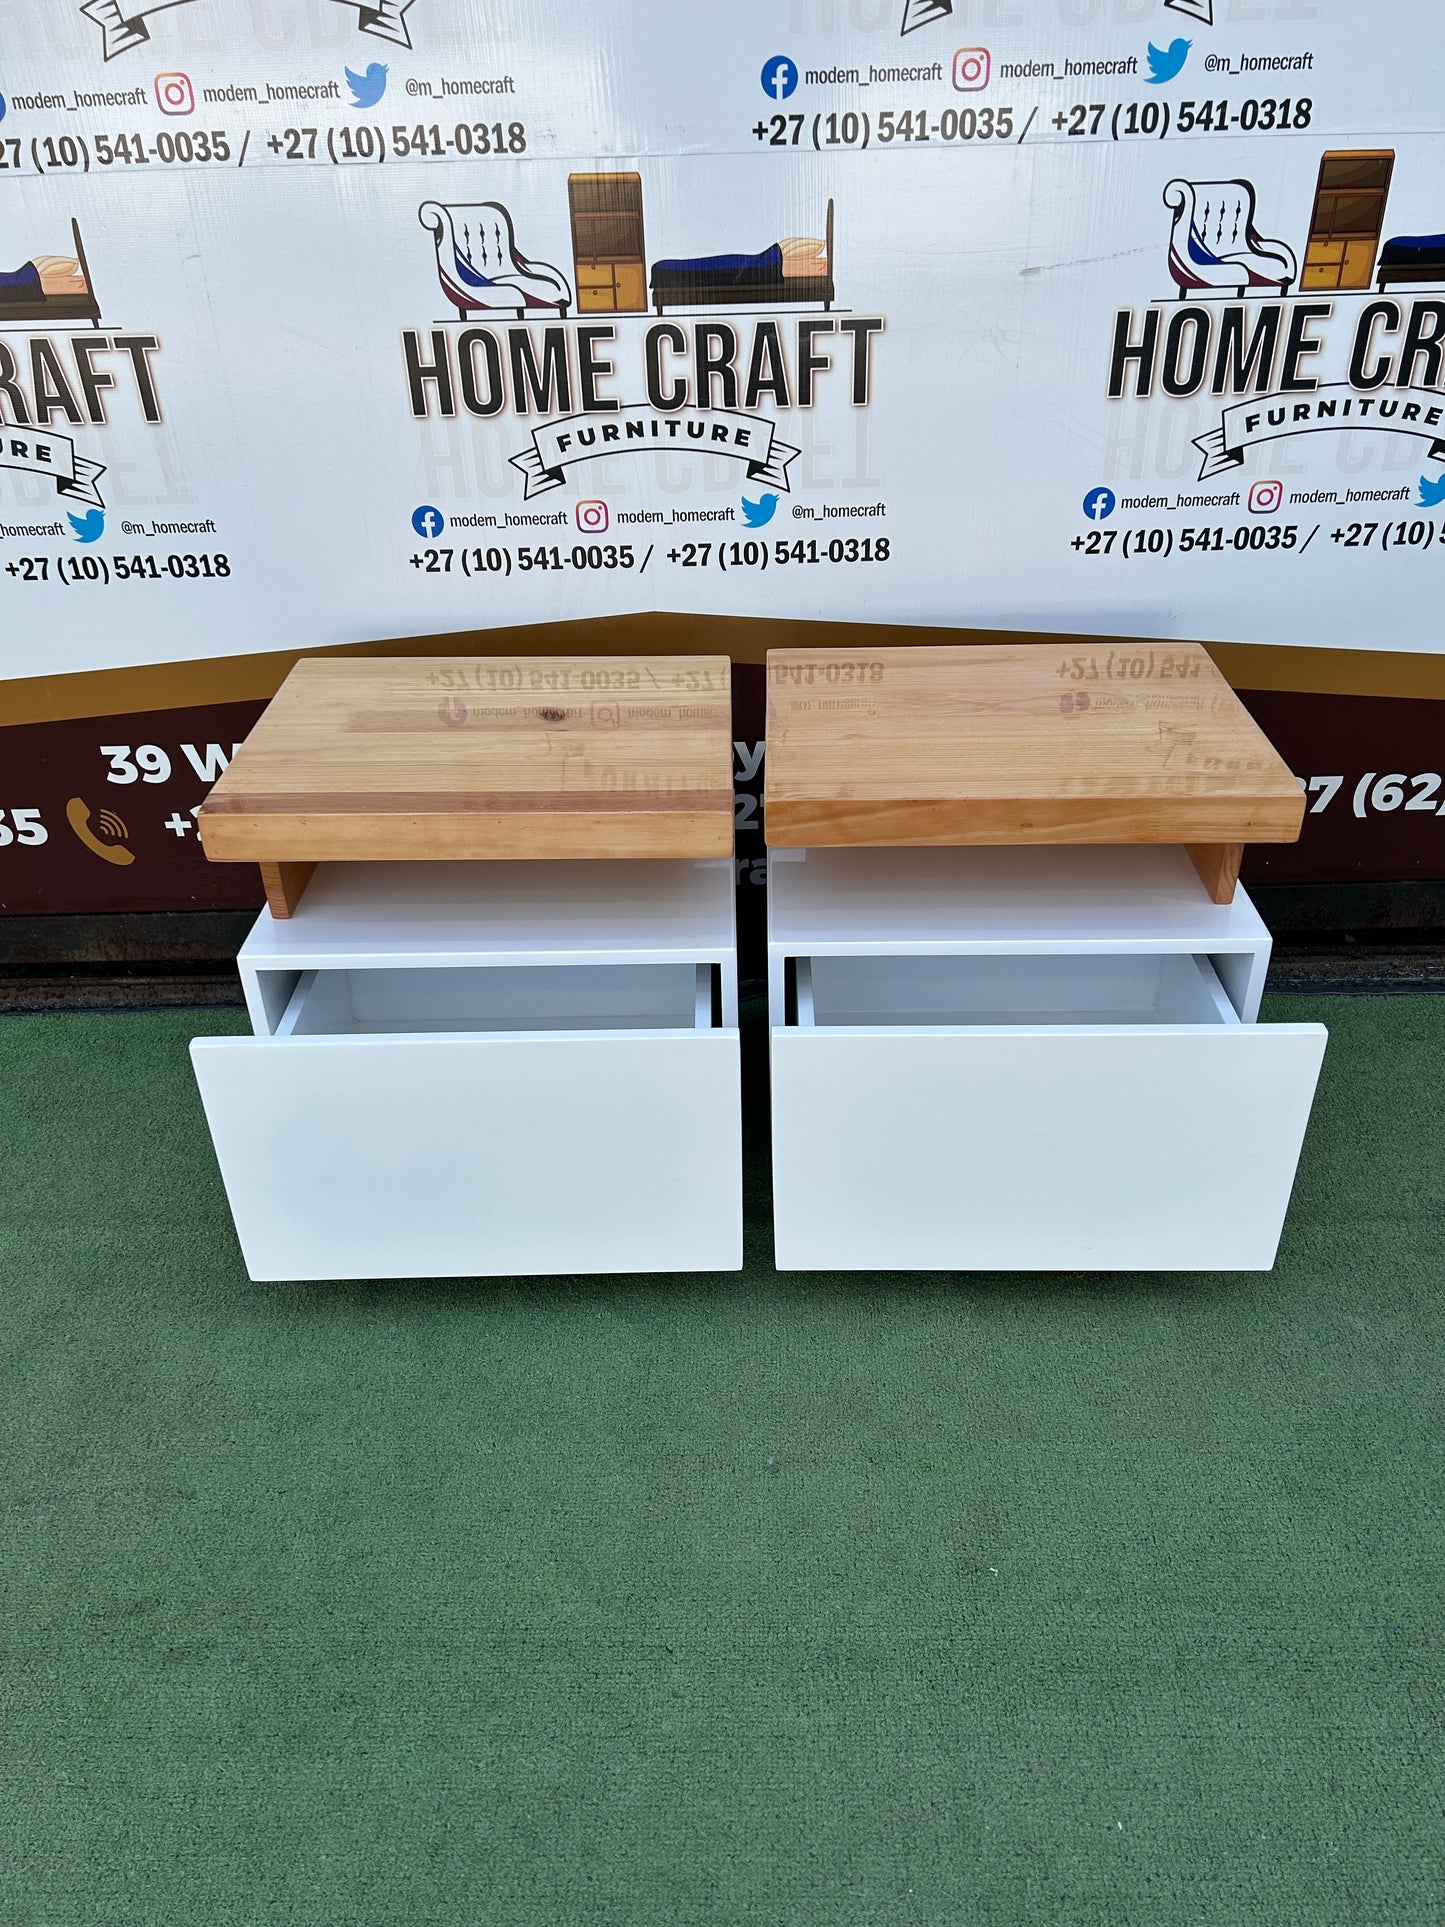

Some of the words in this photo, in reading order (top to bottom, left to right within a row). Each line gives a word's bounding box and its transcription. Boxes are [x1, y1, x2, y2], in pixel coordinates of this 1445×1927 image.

[805, 63, 942, 87] modern_homecraft
[1000, 56, 1138, 80] modern_homecraft
[1204, 52, 1314, 75] @m_homecraft
[11, 88, 148, 111] modern_homecraft
[203, 81, 341, 104] modern_homecraft
[405, 76, 515, 99] @m_homecraft
[752, 114, 805, 146] +27
[812, 112, 870, 151] (10)
[877, 107, 1013, 143] 541-0035
[1051, 104, 1106, 136] +27
[1111, 102, 1170, 141] (10)
[1177, 98, 1312, 133] 541-0318
[31, 135, 90, 174] (10)
[94, 131, 231, 165] 541-0035
[267, 128, 318, 160] +27
[327, 125, 386, 164] (10)
[393, 122, 527, 157] 541-0318
[1107, 303, 1333, 399] HOME
[1348, 300, 1445, 391] CR
[401, 324, 621, 418] HOME
[643, 317, 884, 413] CRAFT
[1245, 399, 1444, 433] FURNITURE
[556, 420, 751, 453] FURNITURE
[1121, 492, 1240, 510] modern_homecraft
[1290, 486, 1410, 505] modern_homecraft
[450, 511, 568, 529] modern_homecraft
[617, 507, 735, 525] modern_homecraft
[792, 503, 886, 521] @m_homecraft
[121, 519, 217, 537] @m_homecraft
[1071, 531, 1117, 554] +27
[1122, 529, 1173, 558] (10)
[1179, 525, 1297, 552] 541-0035
[1331, 522, 1378, 547] +27
[1382, 521, 1434, 551] (10)
[5, 557, 49, 581] +27
[57, 556, 109, 585] (10)
[113, 554, 231, 579] 541-0318
[409, 549, 454, 573] +27
[462, 548, 512, 577] (10)
[518, 545, 635, 571] 541-0035
[667, 543, 712, 567] +27
[718, 541, 769, 571] (10)
[774, 538, 890, 565] 541-0318
[100, 744, 172, 784] 39
[1295, 776, 1345, 813] 7
[1352, 773, 1445, 818] (62
